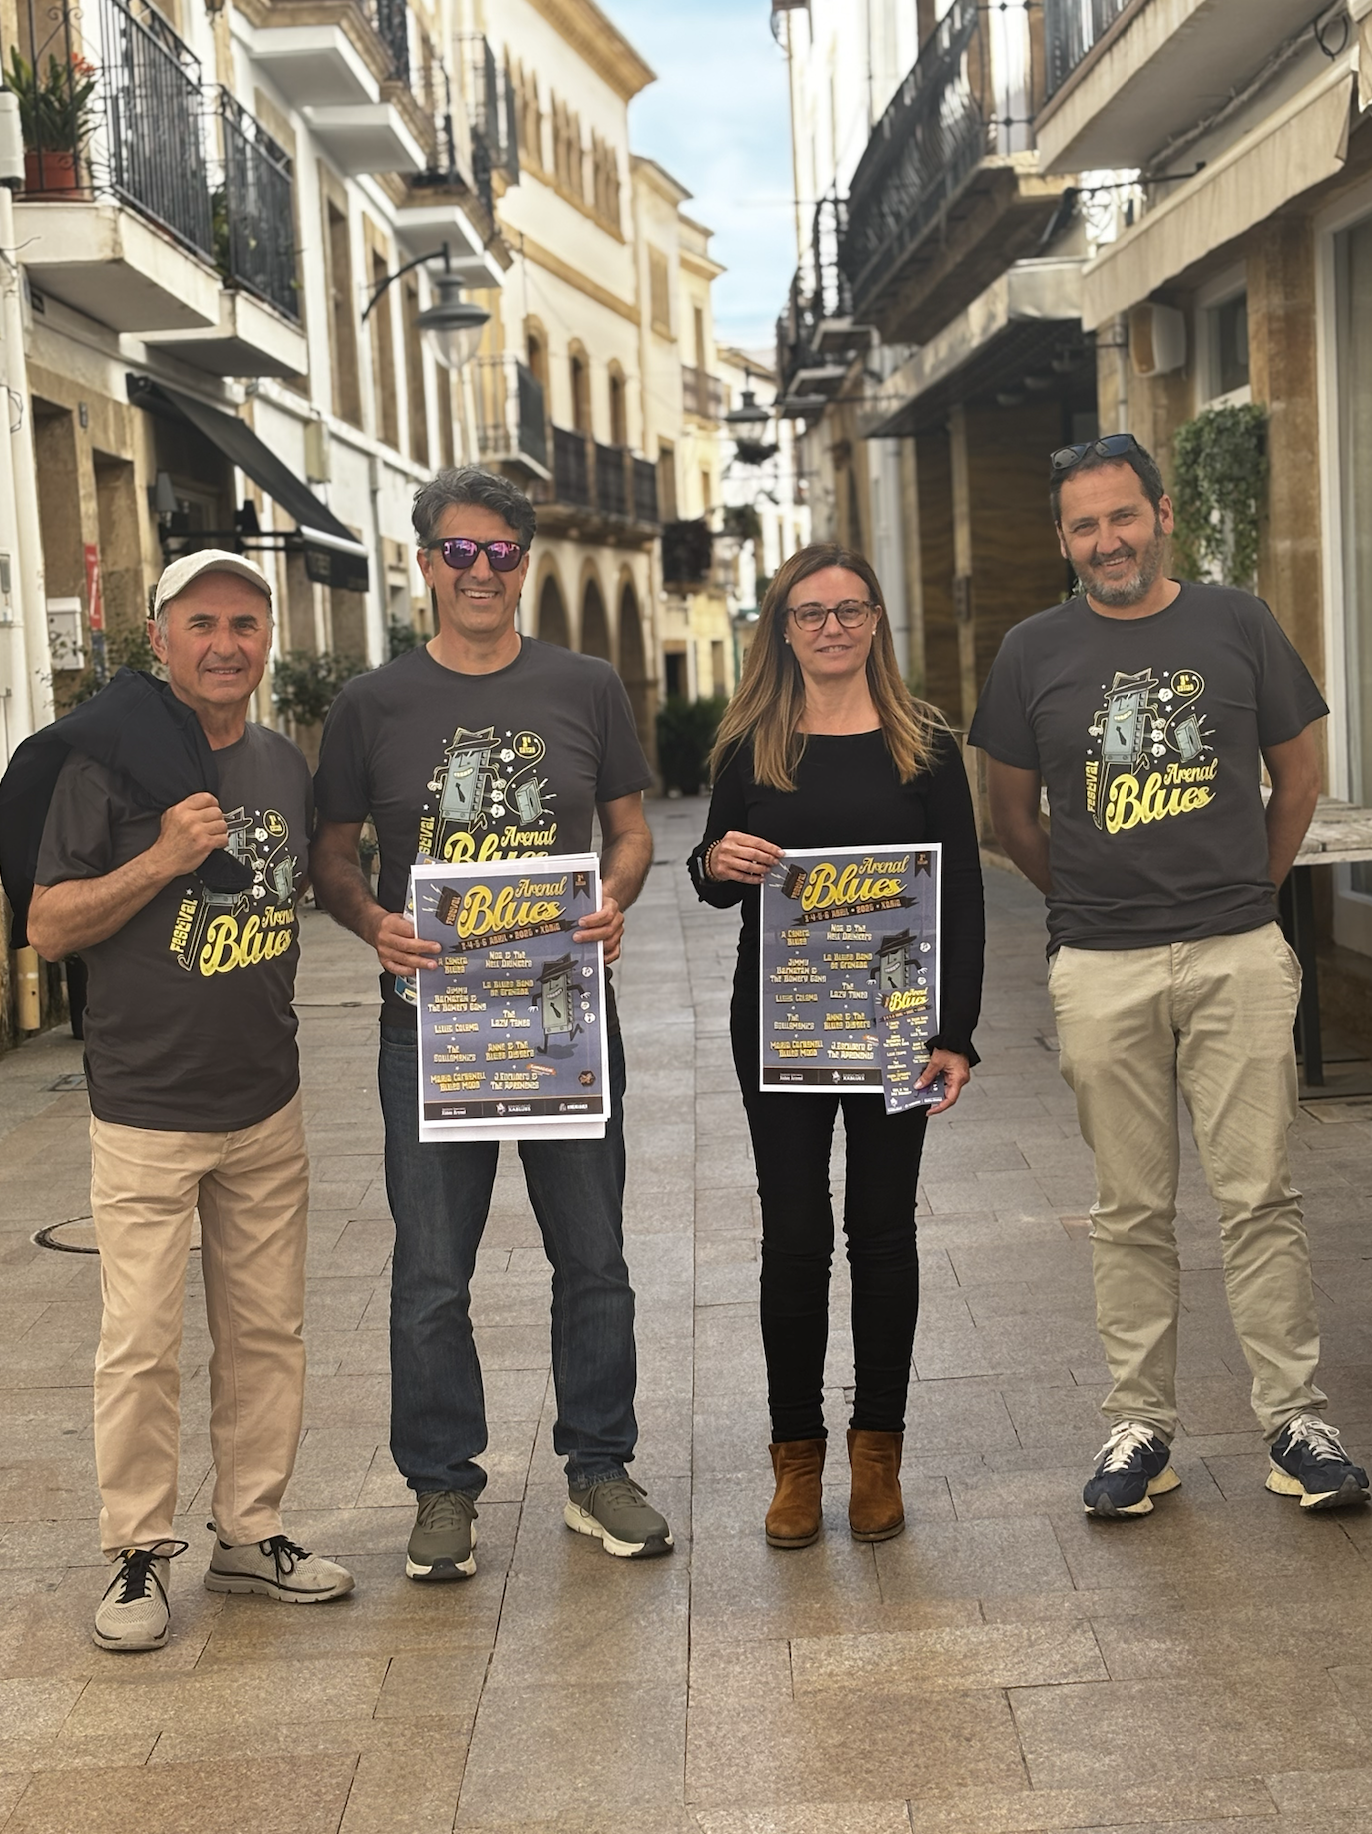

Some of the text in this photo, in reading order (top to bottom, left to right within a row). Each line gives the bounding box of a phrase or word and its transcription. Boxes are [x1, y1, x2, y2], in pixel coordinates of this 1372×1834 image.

[1163, 757, 1218, 786] Arenal
[1105, 773, 1216, 834] Blues
[500, 823, 557, 848] Arenal
[860, 855, 910, 874] Arenal
[515, 876, 568, 898] Arenal
[802, 862, 908, 912] Blues
[458, 885, 567, 938] Blues
[200, 914, 292, 977] Blues
[889, 991, 930, 1012] Blues
